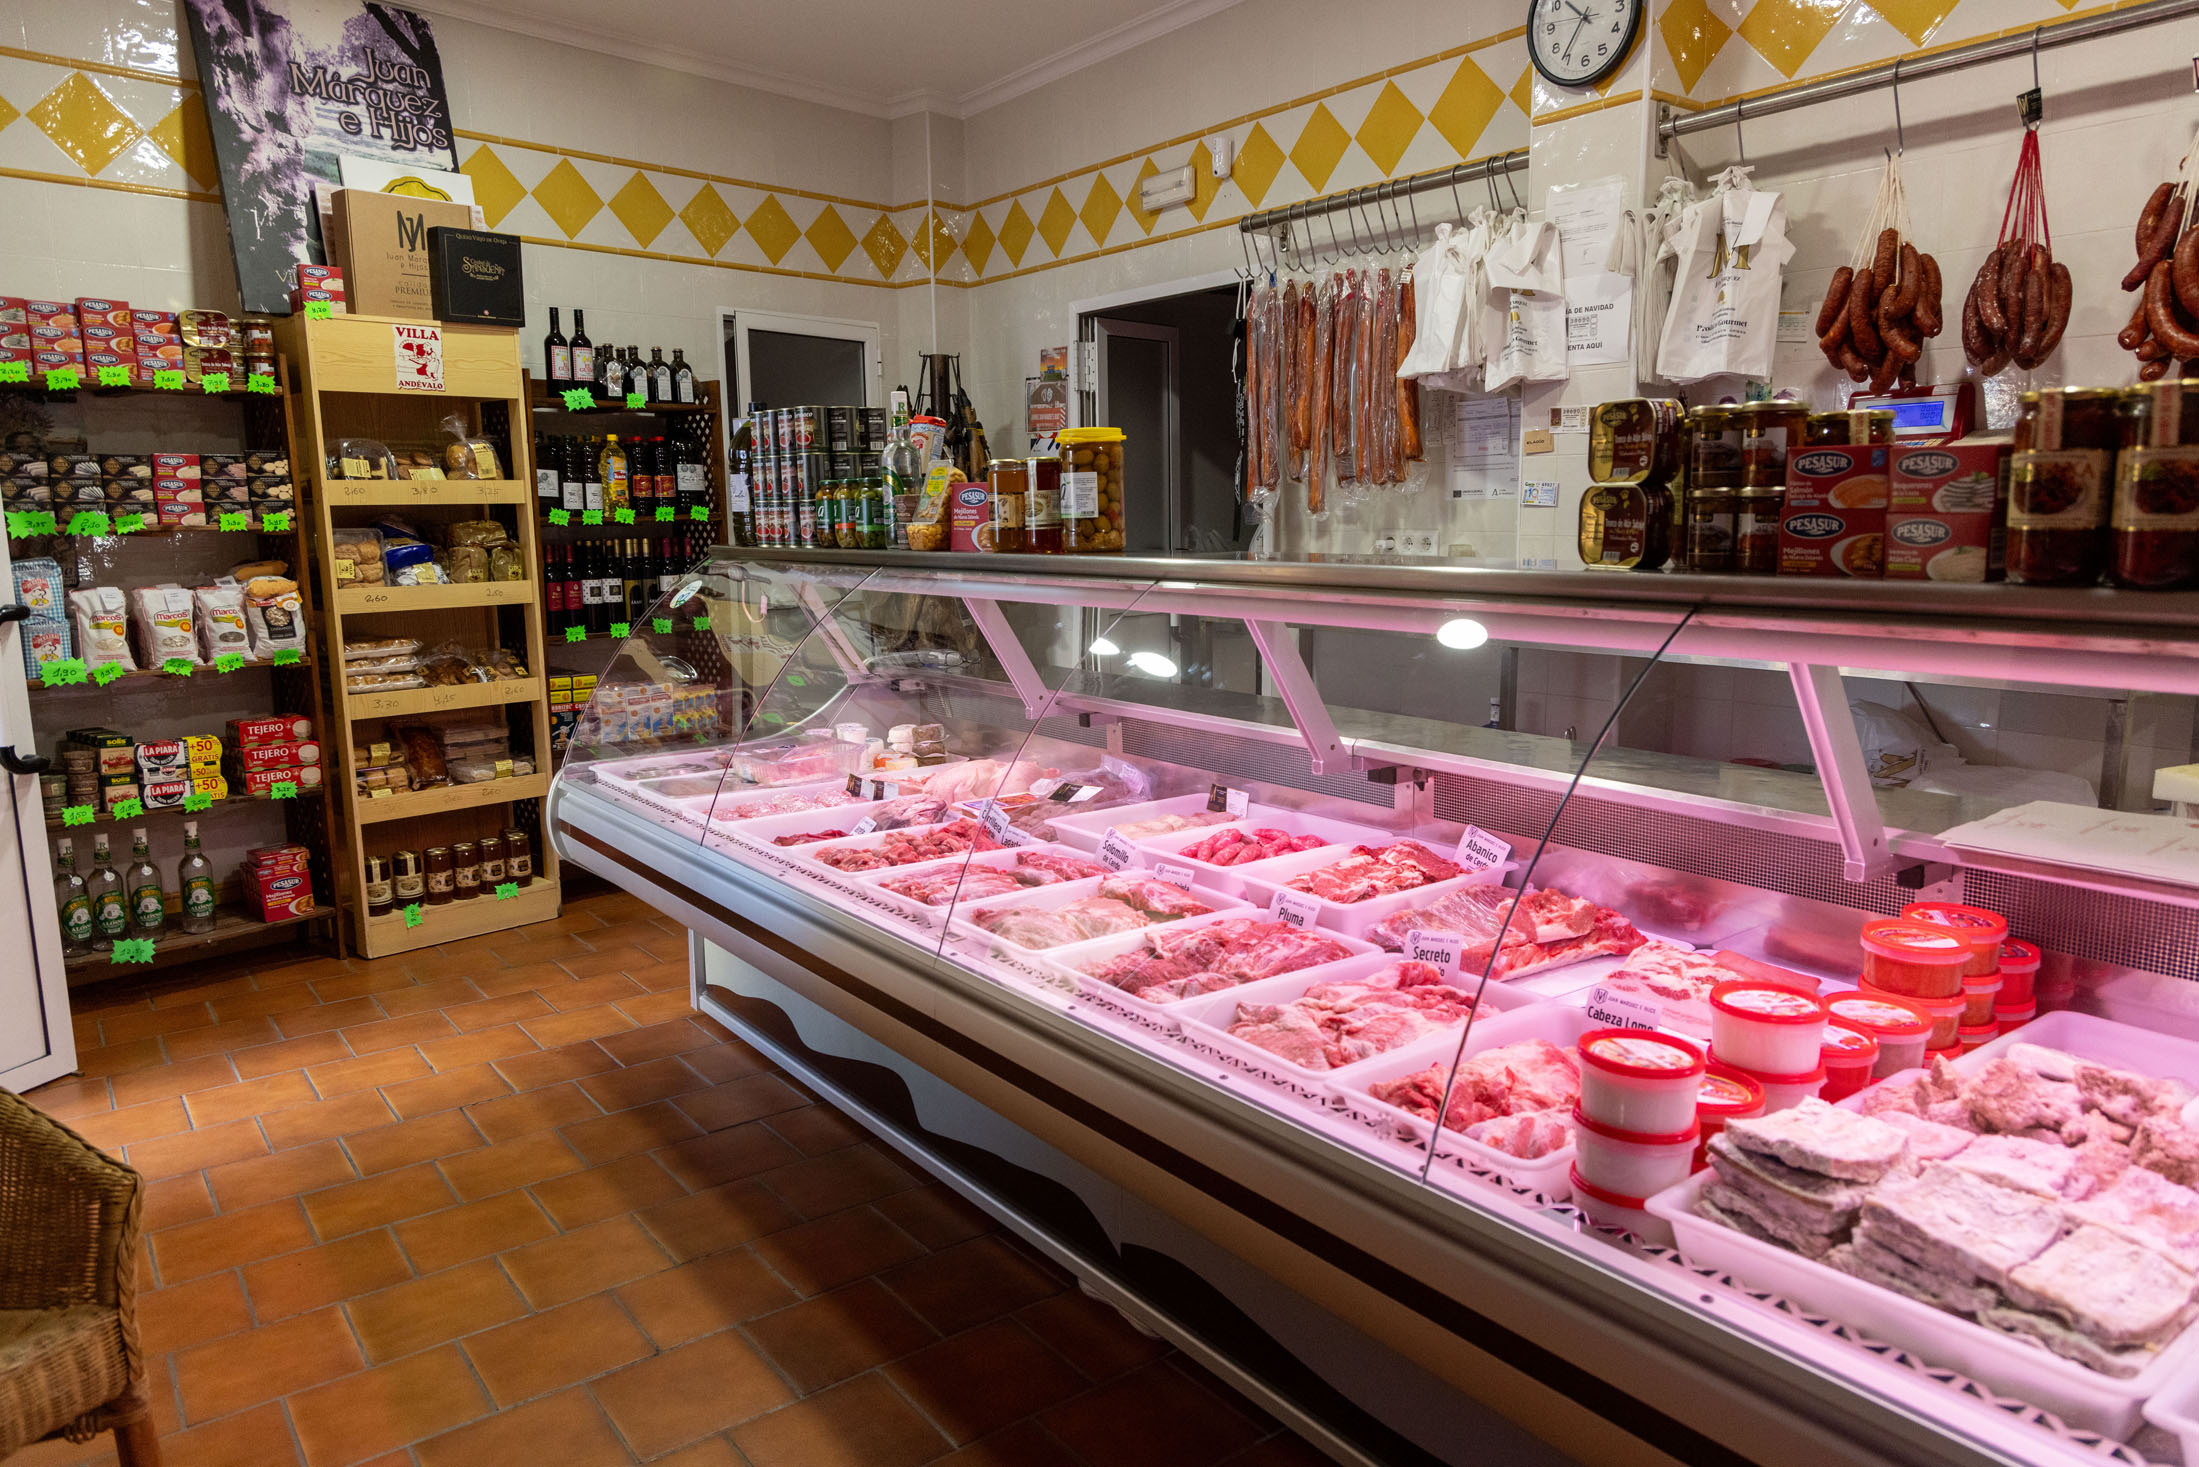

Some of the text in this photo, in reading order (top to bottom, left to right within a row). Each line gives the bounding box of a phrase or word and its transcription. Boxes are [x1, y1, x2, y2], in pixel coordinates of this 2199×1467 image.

[1546, 22, 1556, 35] 9
[1611, 21, 1621, 34] 4
[1551, 42, 1561, 54] 8
[1597, 43, 1608, 56] 5
[1580, 54, 1591, 67] 6
[350, 47, 431, 89] Juan
[339, 105, 449, 149] e Hijos
[407, 253, 429, 265] Marq
[394, 286, 431, 297] PREMIU
[1574, 306, 1583, 314] DE
[1584, 303, 1615, 313] NAVIDAD
[395, 326, 440, 341] VILLA
[1567, 343, 1585, 352] ENTA
[897, 401, 906, 412] R
[1799, 456, 1848, 469] PESASUR
[1901, 456, 1954, 470] PESASUR
[344, 486, 366, 496] 2,60
[411, 486, 438, 496] 3,80
[961, 491, 987, 501] PESASUR
[953, 507, 978, 516] Mejillones
[1789, 519, 1840, 532] PESASUR
[1896, 524, 1946, 538] PESASUR
[364, 594, 389, 604] 2,60
[247, 722, 284, 736] TEJERO
[144, 744, 179, 756] LA PIARA
[251, 746, 289, 760] TEJERO
[191, 753, 219, 763] GRATIS
[254, 769, 292, 783] TEJERO
[151, 783, 185, 796] LA PIARA
[1102, 839, 1130, 864] Solomillo
[1465, 839, 1498, 864] Abanico
[1465, 853, 1474, 862] de
[1278, 906, 1305, 927] Pluma
[1412, 945, 1451, 964] Secreto
[1587, 1005, 1623, 1027] Cabeza
